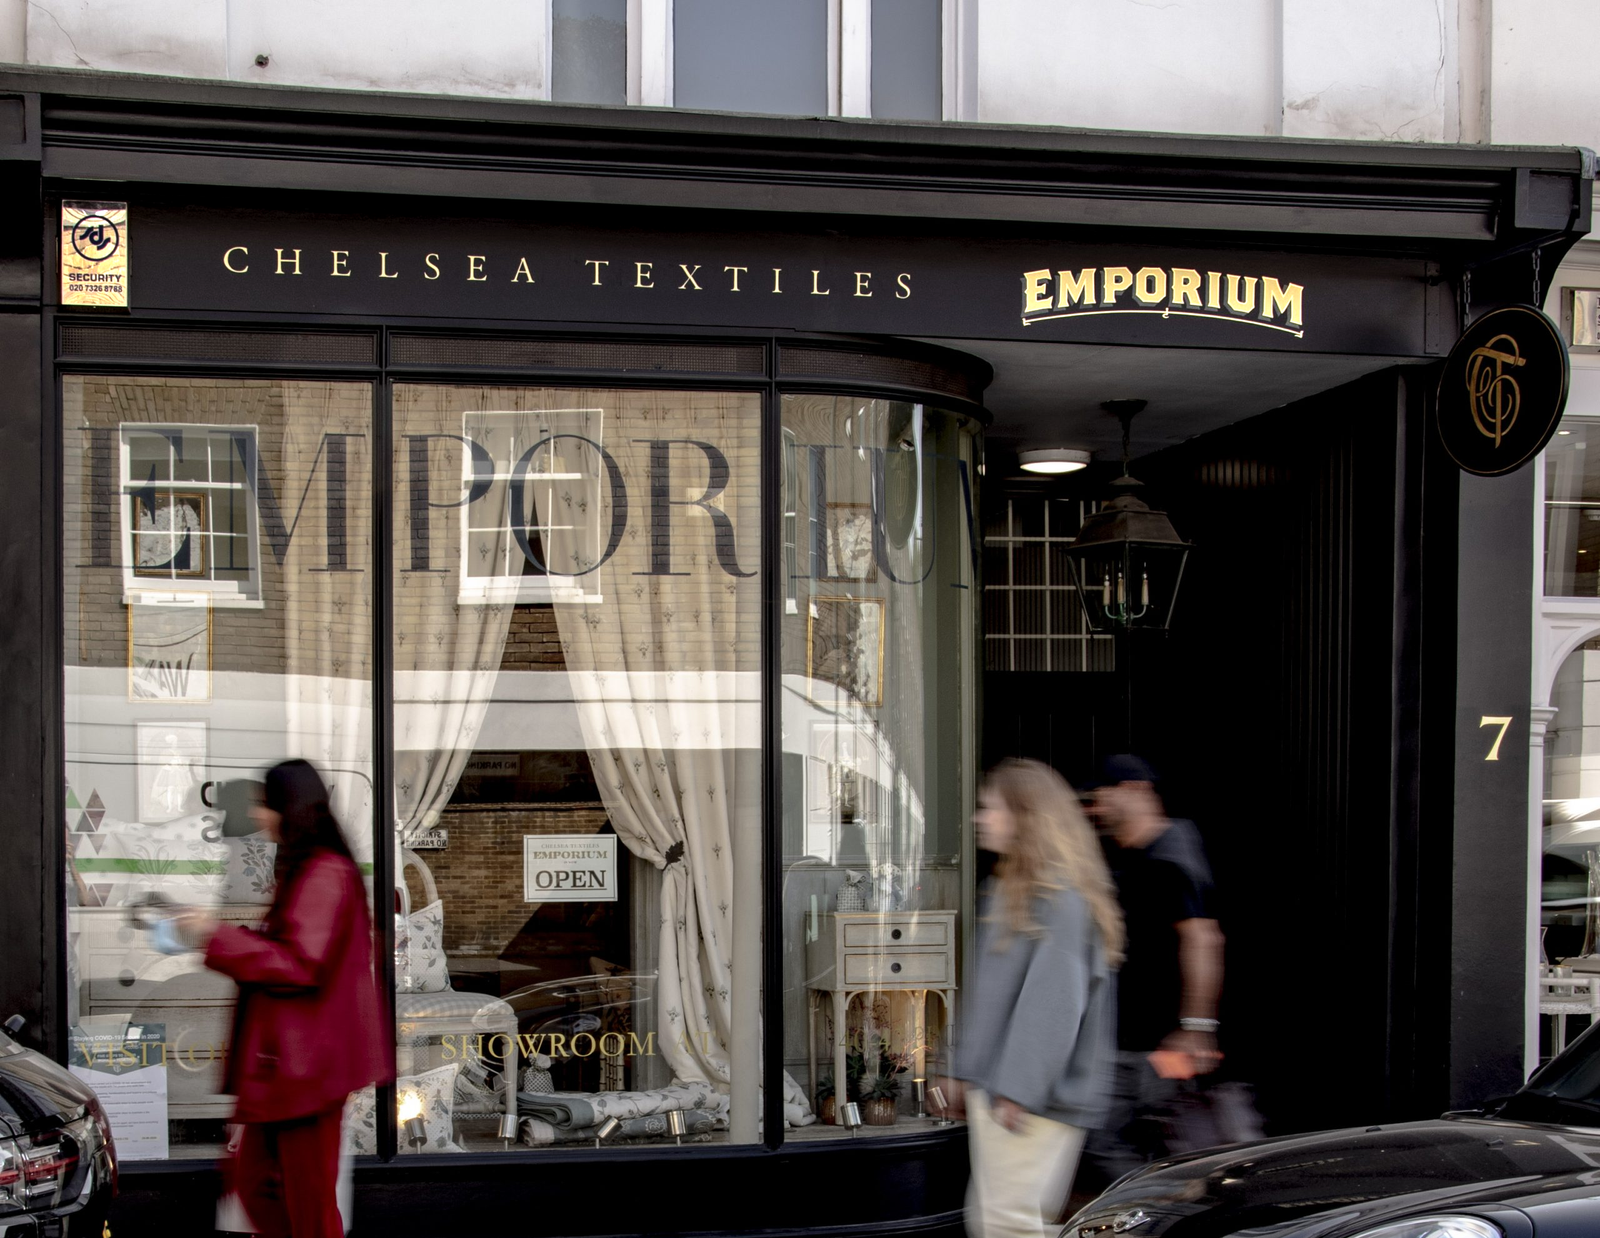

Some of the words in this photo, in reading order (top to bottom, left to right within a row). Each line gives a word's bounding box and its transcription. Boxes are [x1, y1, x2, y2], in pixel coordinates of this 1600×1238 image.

[69, 273, 122, 283] SECURITY
[222, 246, 536, 284] CHELSEA
[584, 259, 912, 299] TEXTILES
[69, 284, 83, 292] 020
[1020, 266, 1304, 328] EMPORIUM
[1478, 716, 1513, 761] 7
[533, 850, 608, 859] EMPORIUM
[535, 869, 607, 889] OPEN
[78, 1041, 175, 1068] VISIT
[441, 1031, 657, 1060] SHOWROOM
